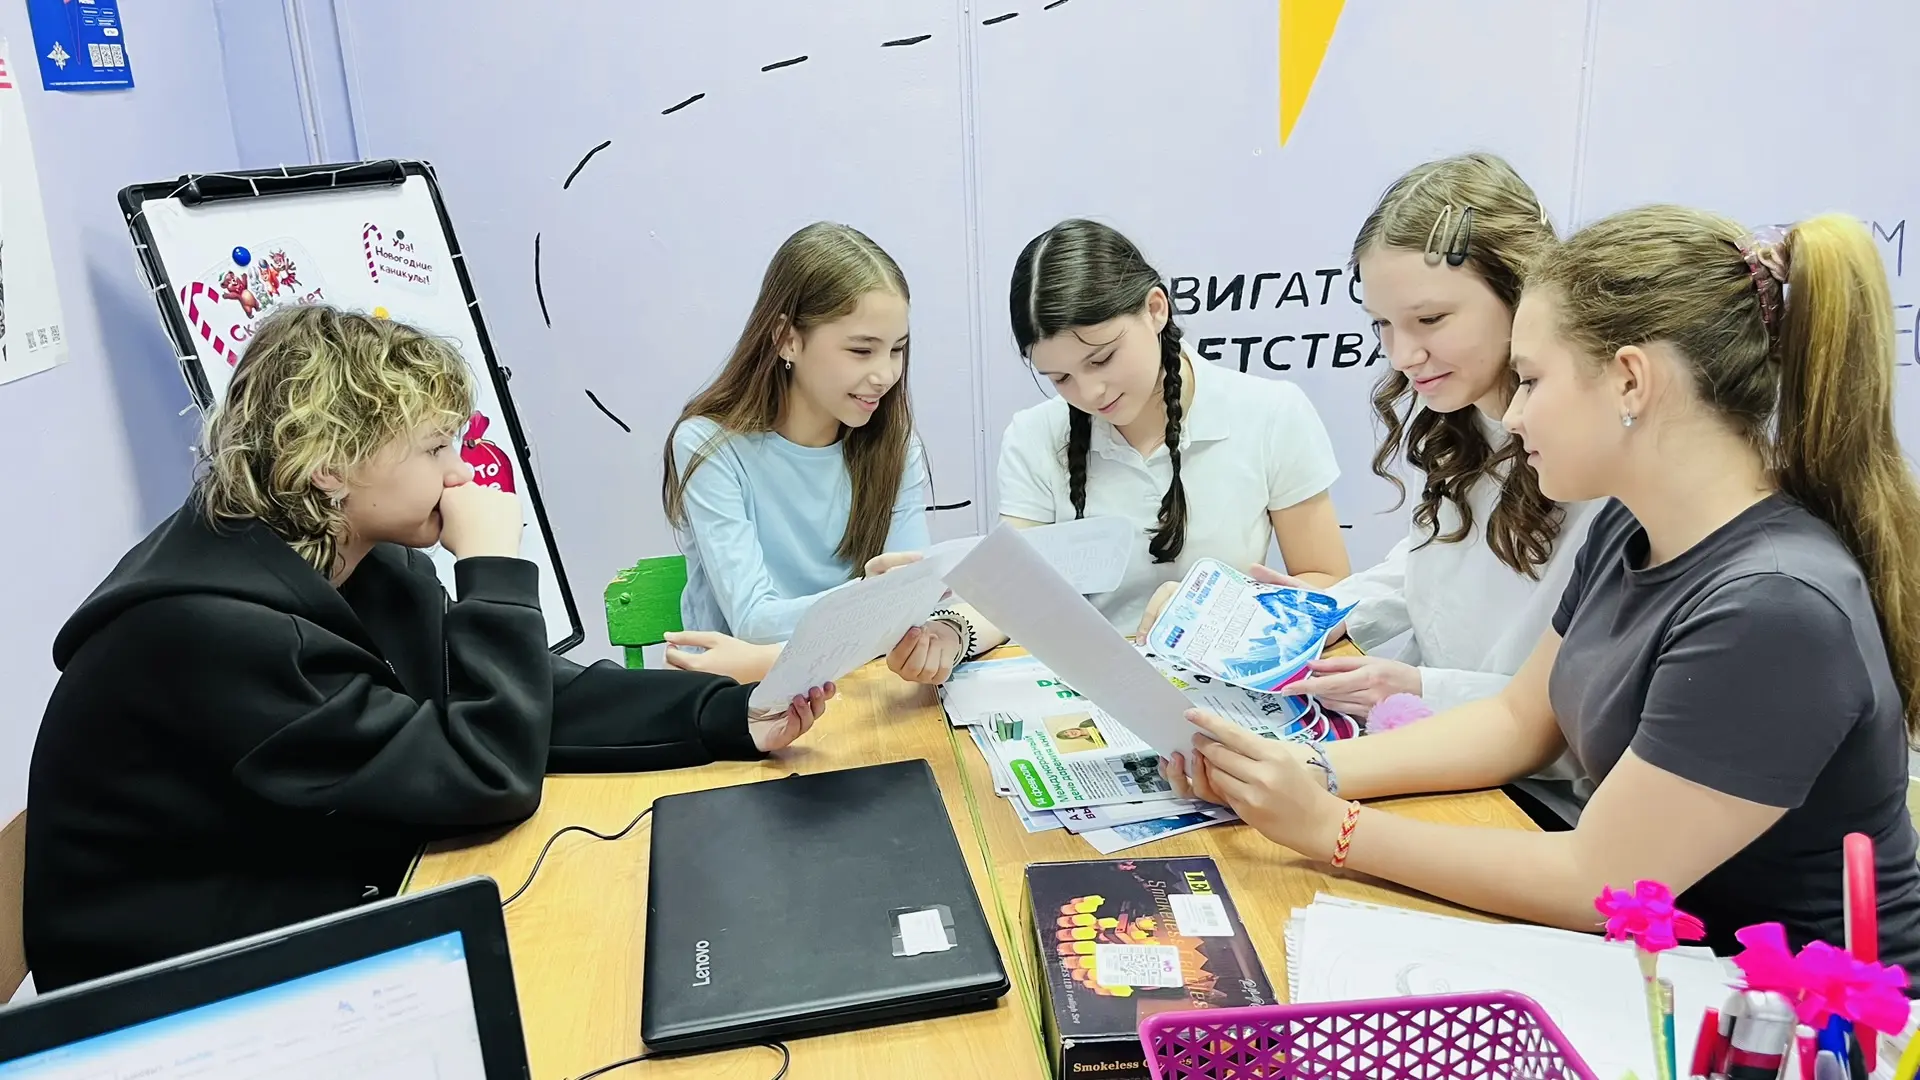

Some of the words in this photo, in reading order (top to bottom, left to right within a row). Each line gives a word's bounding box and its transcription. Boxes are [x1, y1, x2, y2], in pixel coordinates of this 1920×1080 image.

[392, 238, 415, 253] Ура!
[375, 246, 433, 272] Новогодние
[380, 264, 431, 285] каникулы!
[1171, 268, 1363, 316] ВИГАТ
[1197, 332, 1387, 374] ЕТСТВА
[473, 463, 500, 479] ТО
[1034, 729, 1050, 748] книг
[1022, 735, 1071, 803] Международный
[1046, 748, 1073, 781] дарения
[1017, 763, 1045, 797] февраля
[1067, 780, 1085, 801] день
[1035, 797, 1047, 806] 14
[1184, 871, 1214, 895] LE
[692, 940, 710, 987] Lenovo
[1073, 1060, 1139, 1073] Smokeless
